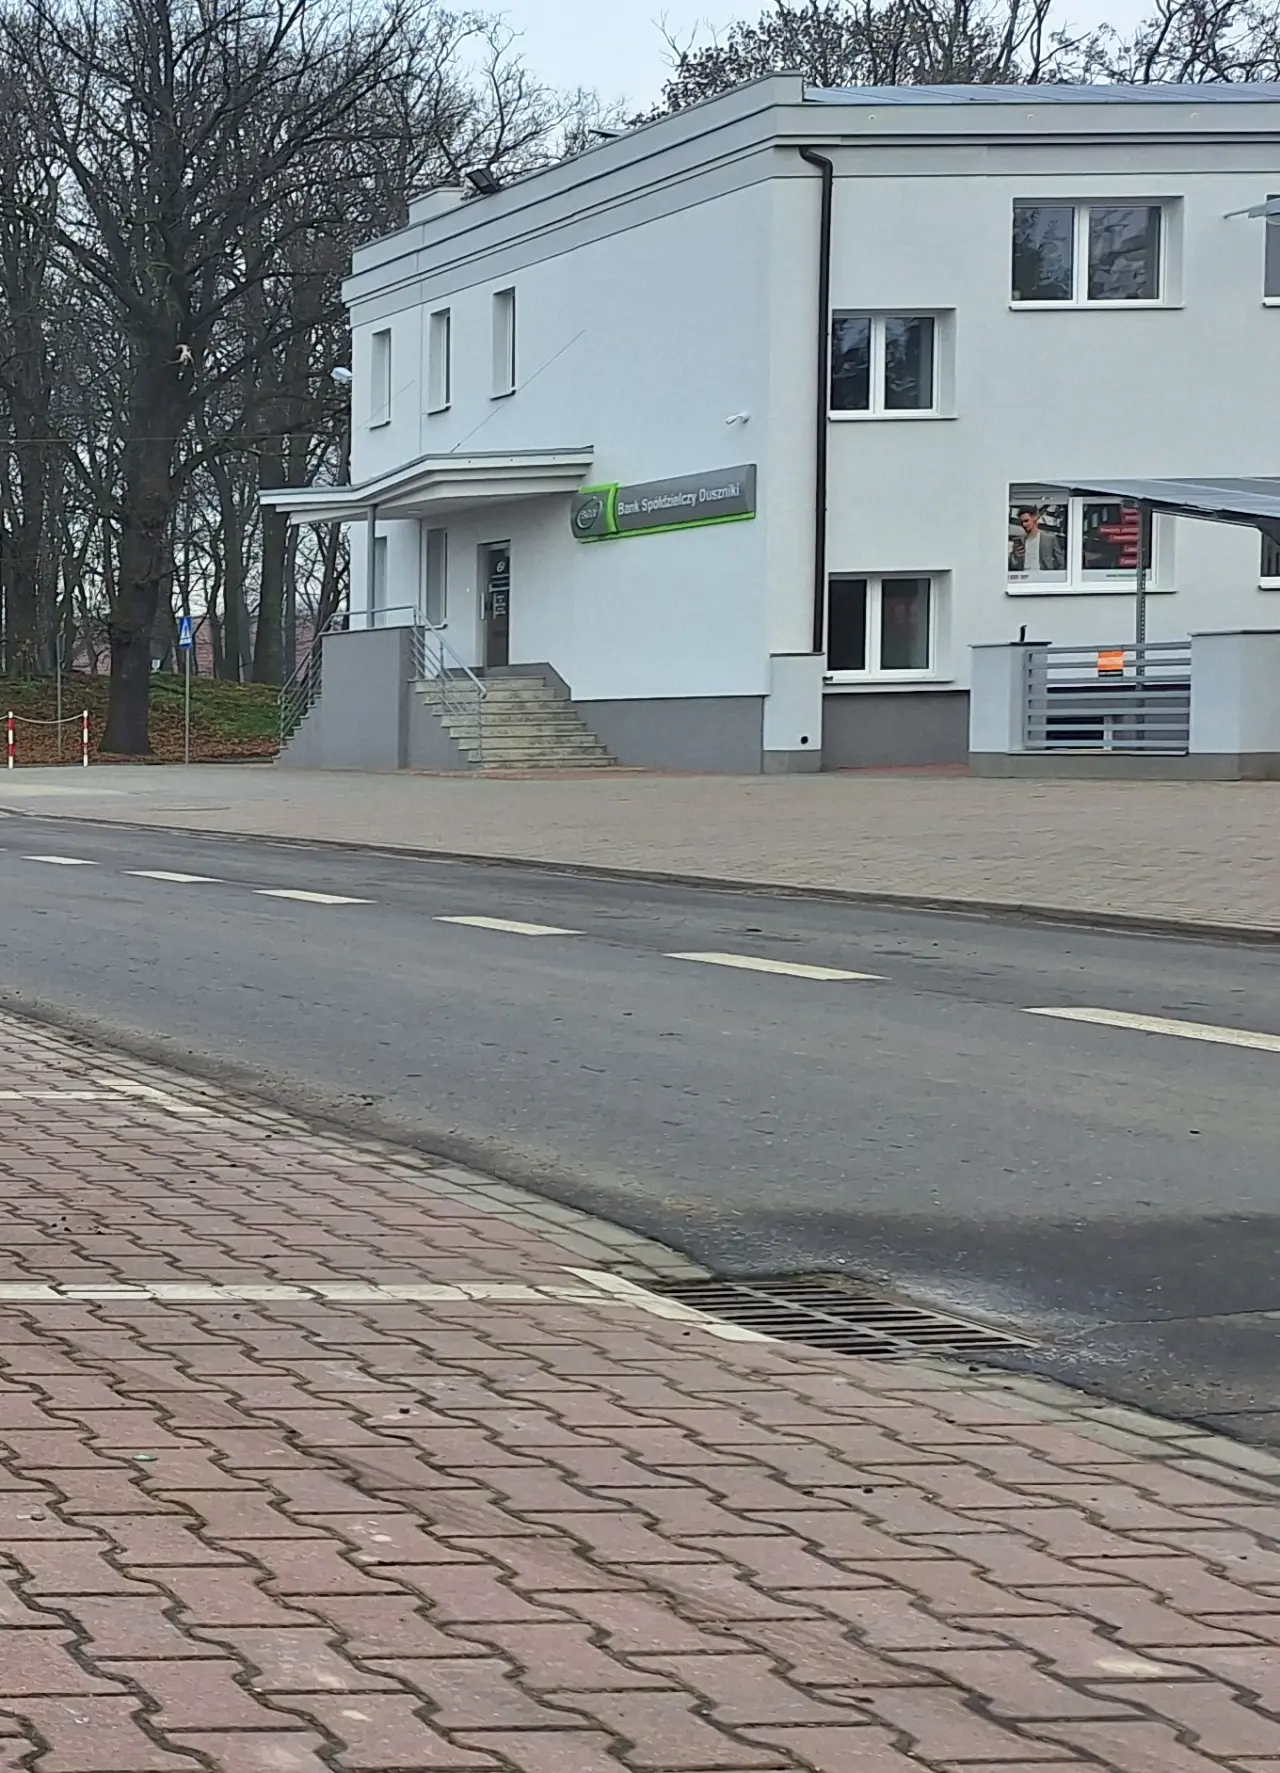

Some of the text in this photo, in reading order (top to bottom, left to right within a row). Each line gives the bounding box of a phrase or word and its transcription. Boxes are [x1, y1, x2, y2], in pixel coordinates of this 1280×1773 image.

[617, 500, 640, 516] Bank
[641, 492, 697, 516] Spółdzielczy
[699, 482, 740, 502] Duszniki
